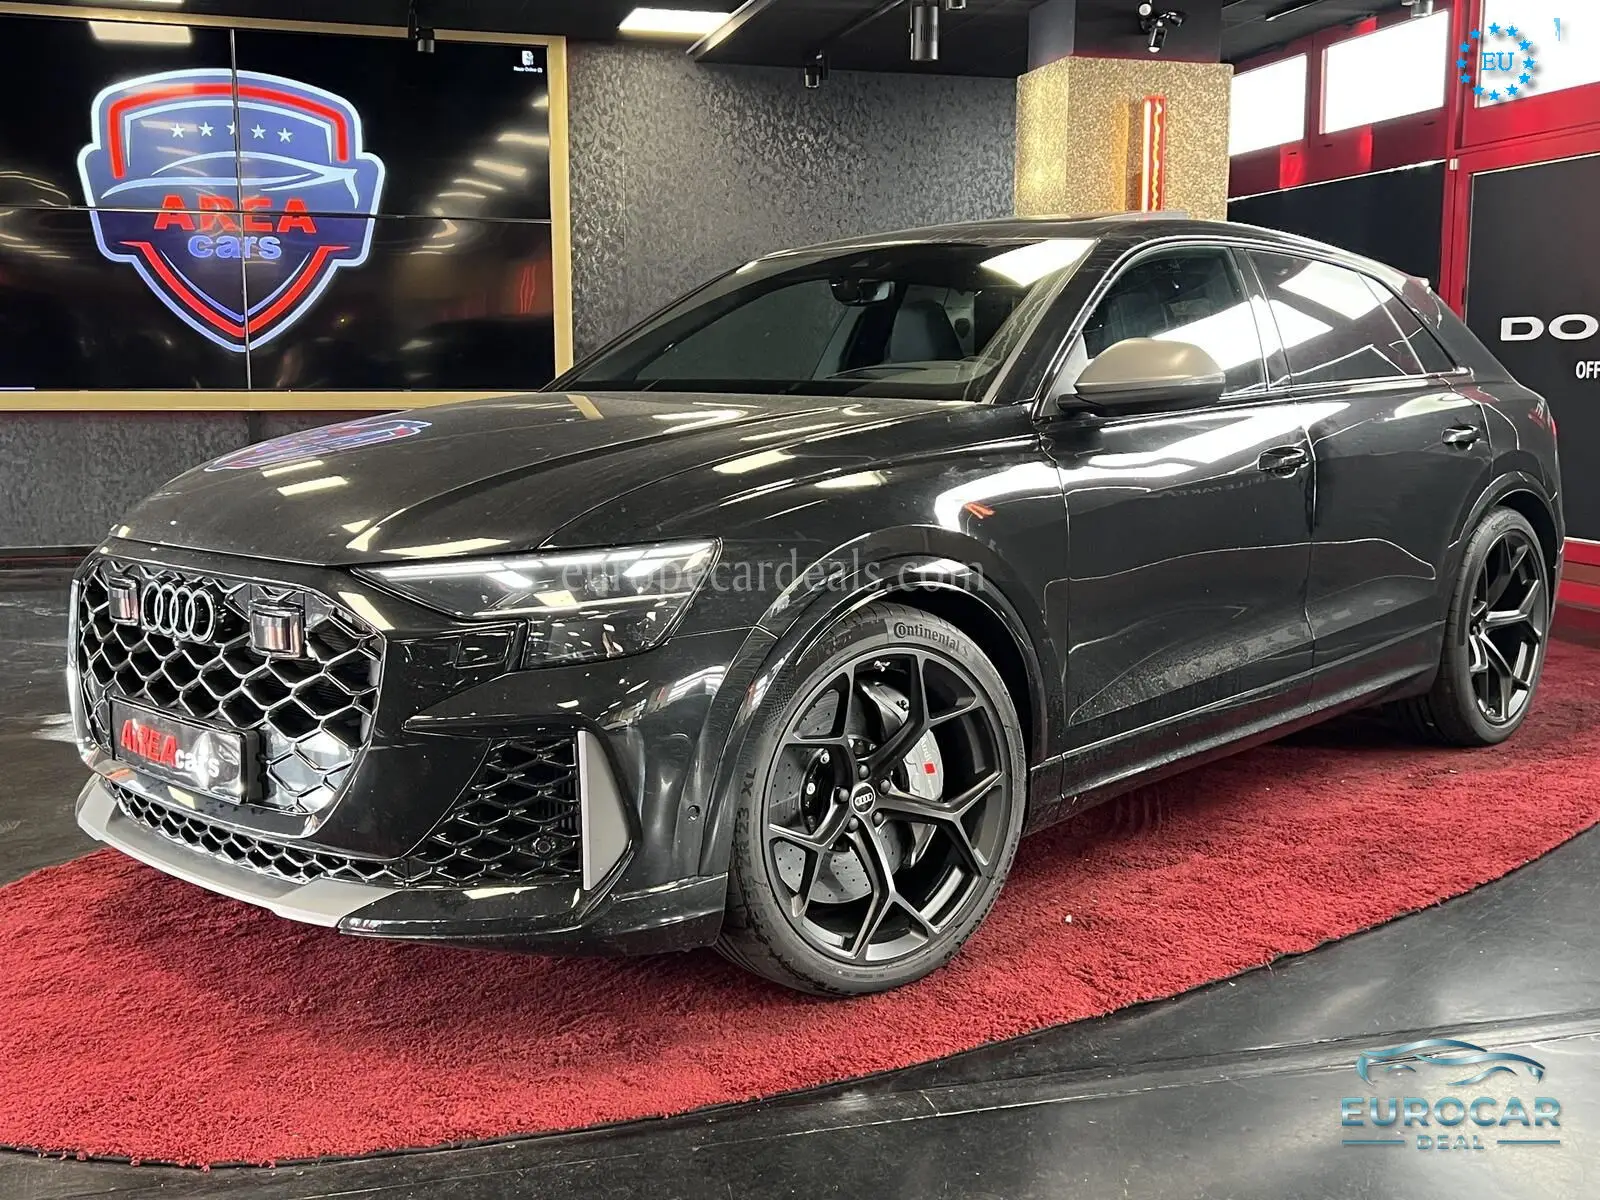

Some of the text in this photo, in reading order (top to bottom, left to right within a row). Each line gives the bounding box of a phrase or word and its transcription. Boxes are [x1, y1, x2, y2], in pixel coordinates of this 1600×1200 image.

[154, 194, 317, 234] AREA
[187, 234, 282, 260] cars
[893, 621, 960, 653] Continental
[740, 767, 757, 797] XL
